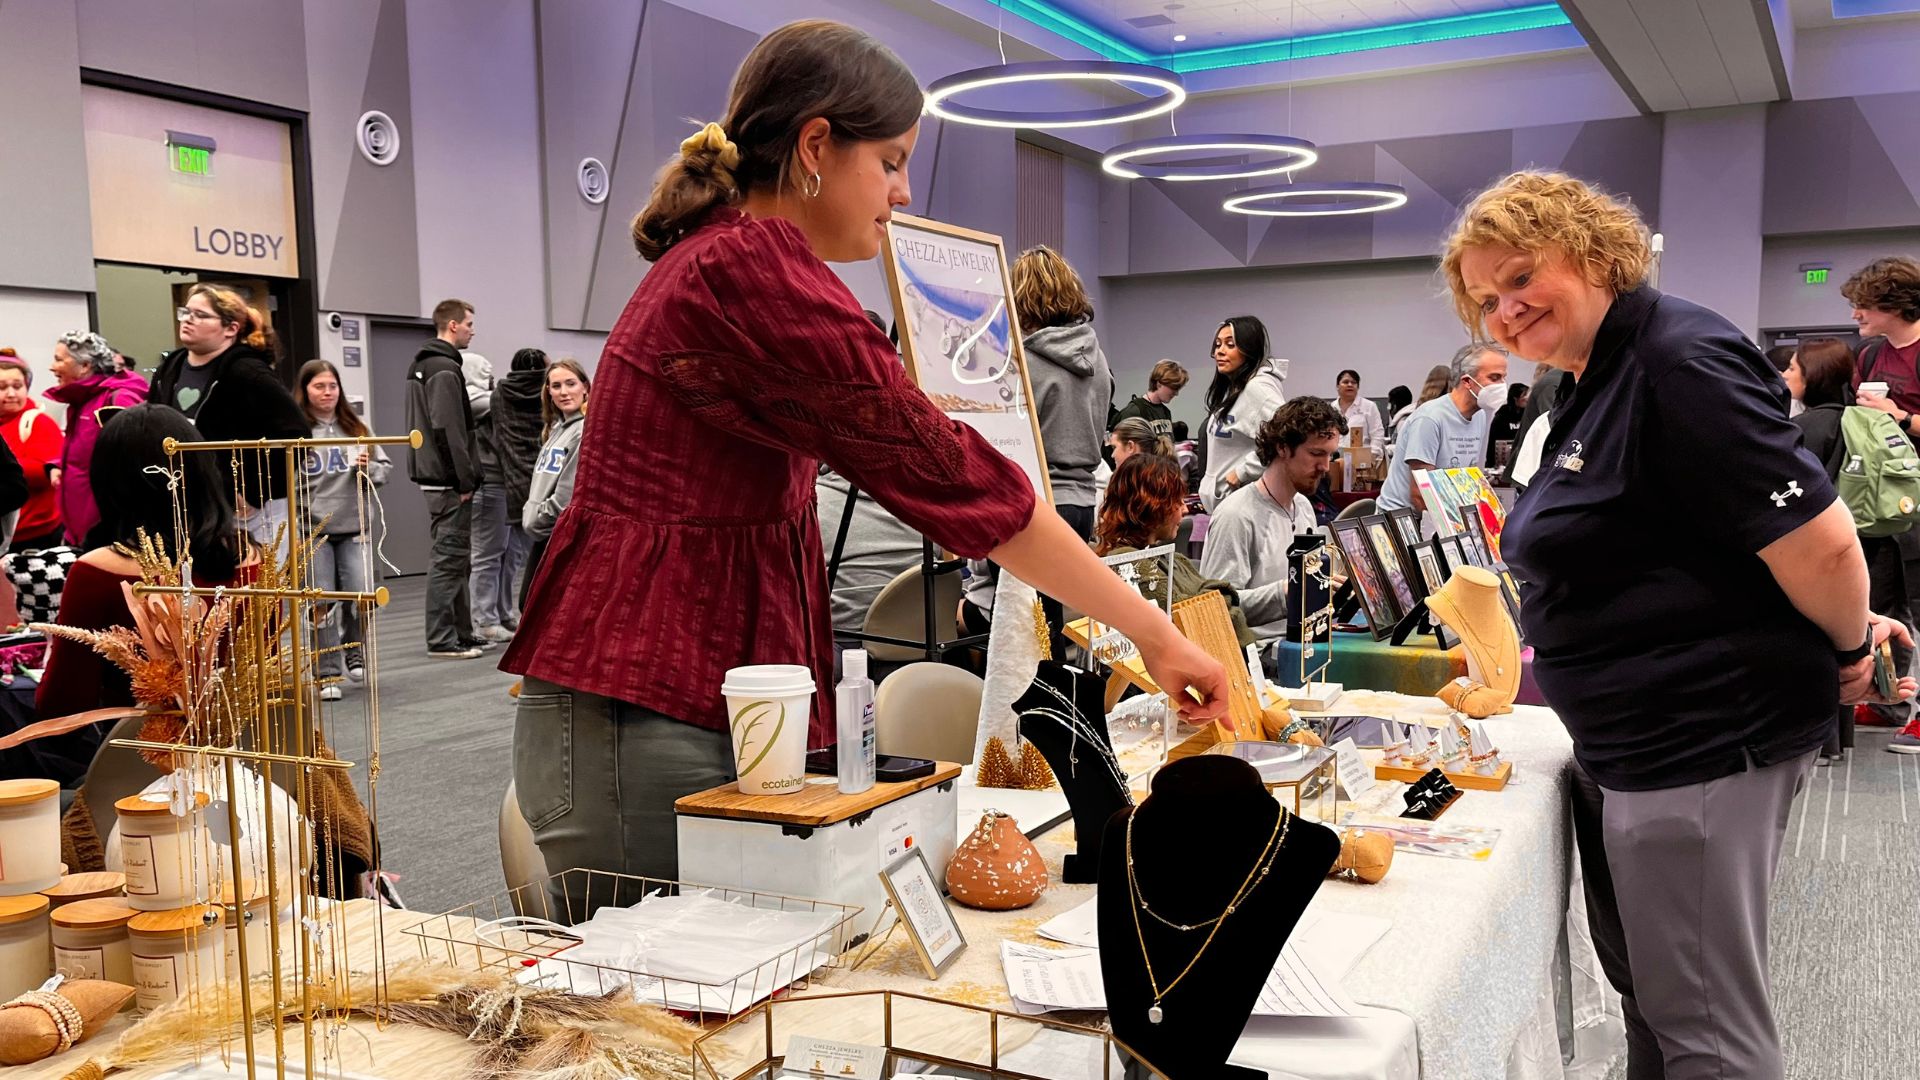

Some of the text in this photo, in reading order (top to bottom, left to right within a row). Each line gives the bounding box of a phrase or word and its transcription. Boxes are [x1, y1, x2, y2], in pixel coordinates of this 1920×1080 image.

[178, 146, 209, 176] EXIT
[193, 226, 283, 260] LOBBY
[895, 237, 996, 274] CHEZZA JEWELRY
[1807, 269, 1828, 284] EXIT
